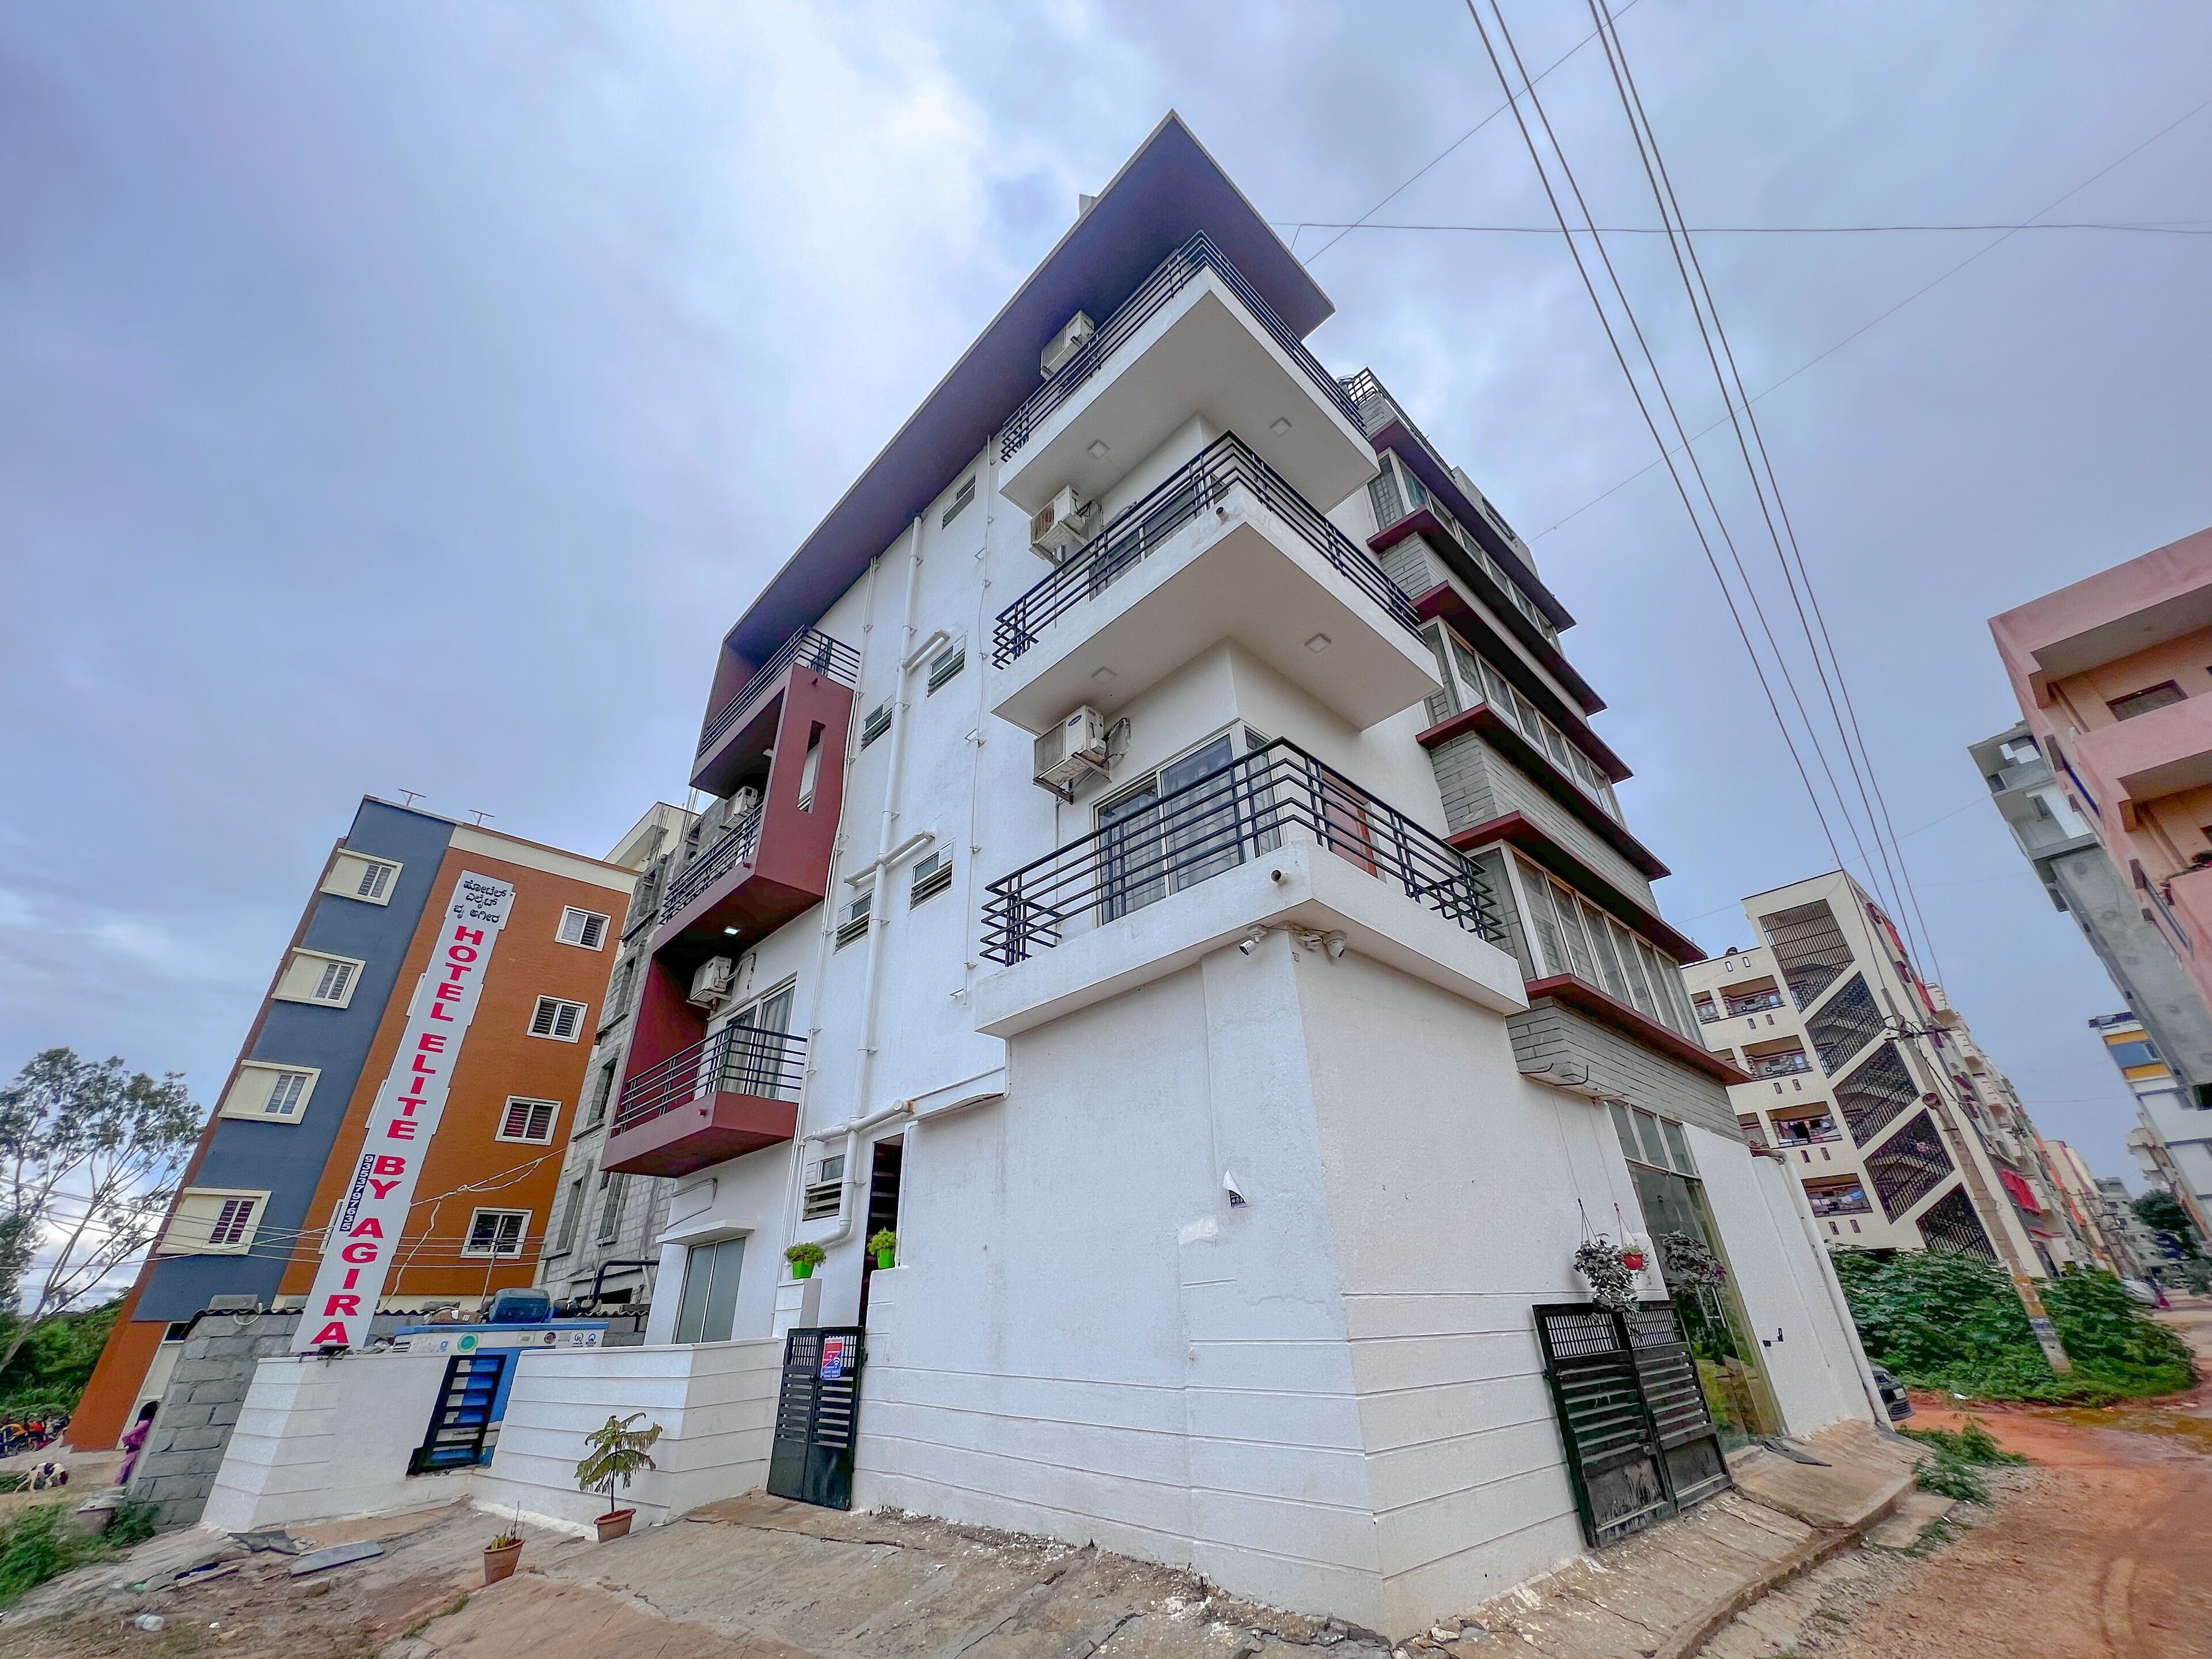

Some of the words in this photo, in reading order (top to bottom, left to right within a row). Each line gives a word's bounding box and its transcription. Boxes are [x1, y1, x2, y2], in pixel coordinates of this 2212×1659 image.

[463, 880, 507, 897] ಹೋಟೆಲ್
[431, 925, 484, 1022] HOTEL
[387, 1032, 446, 1140] ELITE
[340, 1155, 374, 1231] 9353797635
[368, 1155, 406, 1199] BY
[312, 1218, 384, 1344] AGIRA
